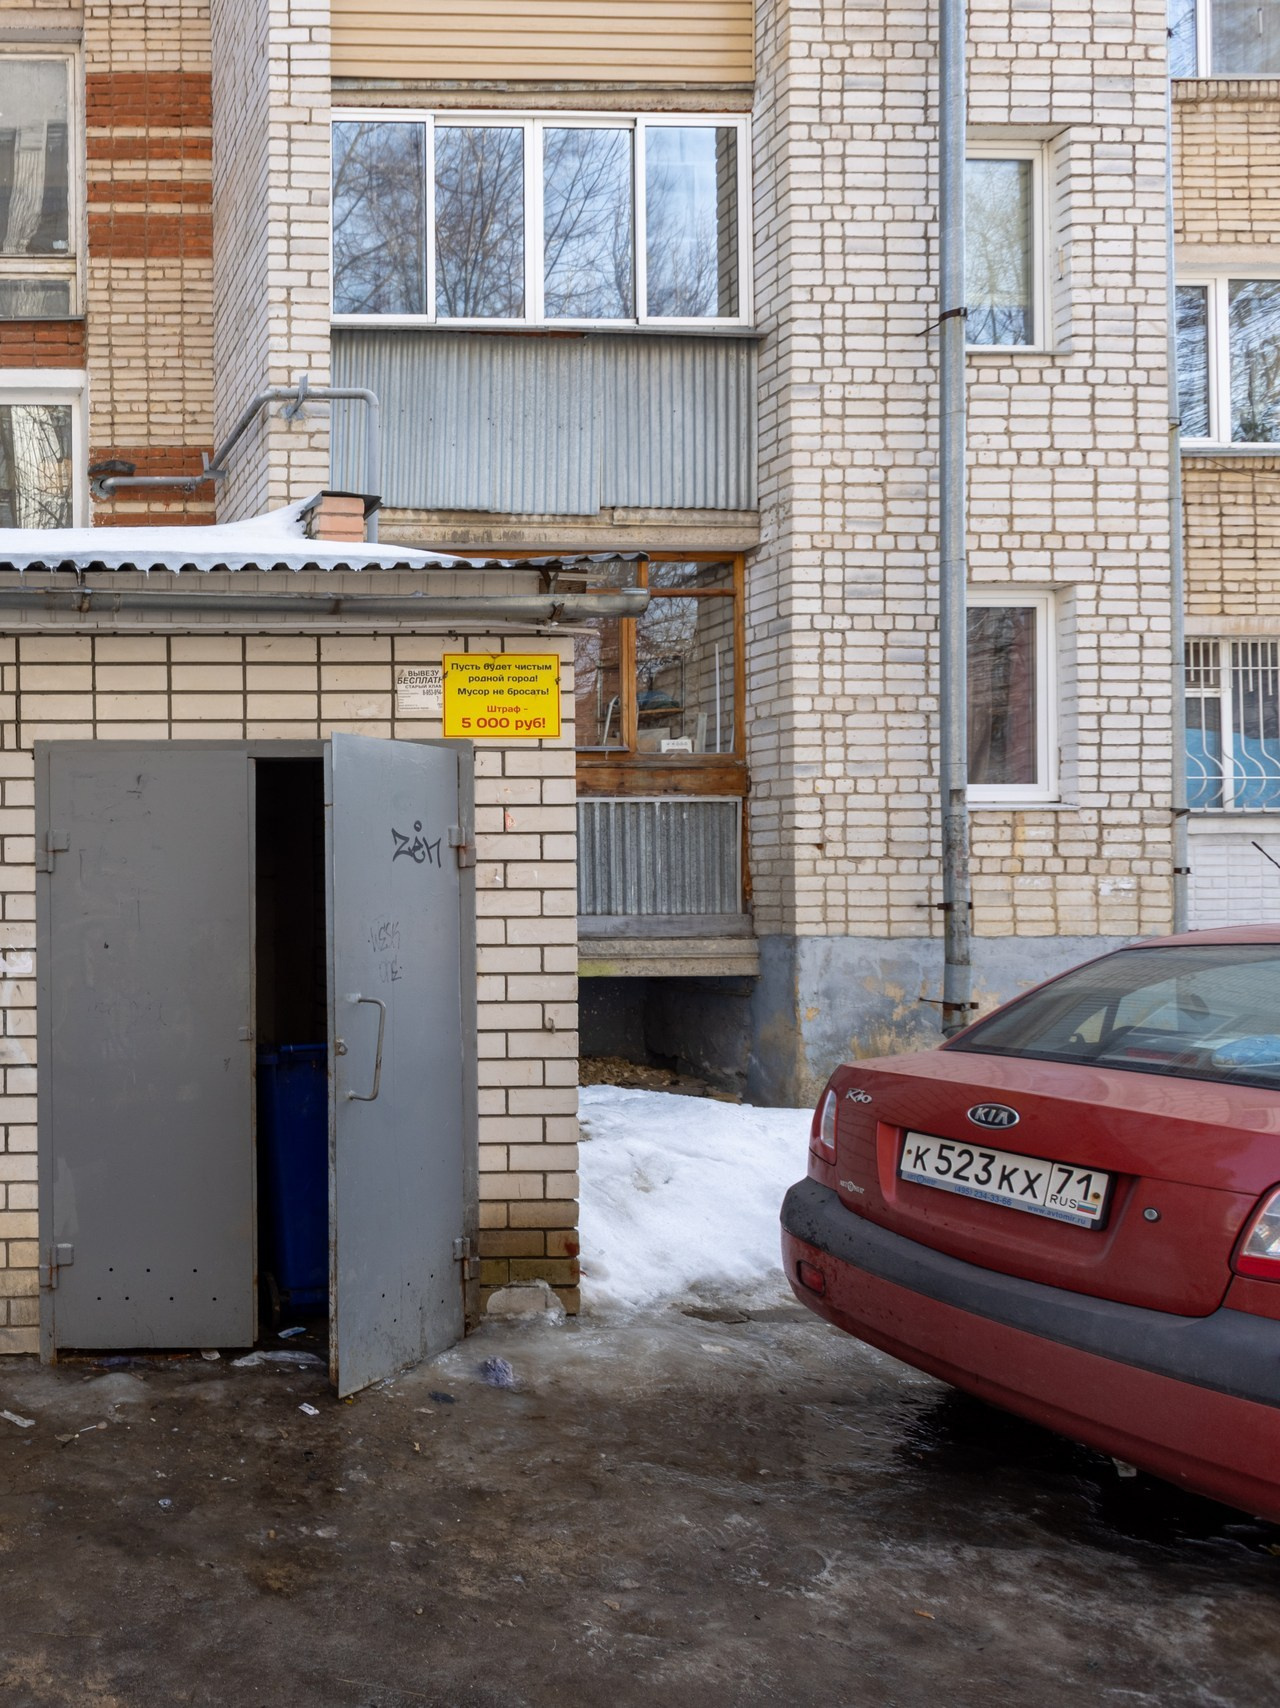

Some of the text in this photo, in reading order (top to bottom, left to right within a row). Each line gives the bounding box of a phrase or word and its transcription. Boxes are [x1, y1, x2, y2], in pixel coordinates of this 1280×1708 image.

[451, 663, 480, 671] Пусть
[483, 663, 511, 671] будет
[468, 674, 538, 683] родной город!
[457, 688, 490, 697] Мусор
[507, 687, 549, 696] бросать!
[487, 705, 521, 714] Штраф
[461, 717, 546, 730] 5 000 руб!
[846, 1087, 873, 1104] Rio
[974, 1107, 1008, 1124] KIA
[1056, 1167, 1093, 1201] 71
[954, 1184, 973, 1196] (495)
[1026, 1204, 1086, 1225] www.avtomir.ru
[1049, 1194, 1078, 1209] RUS
